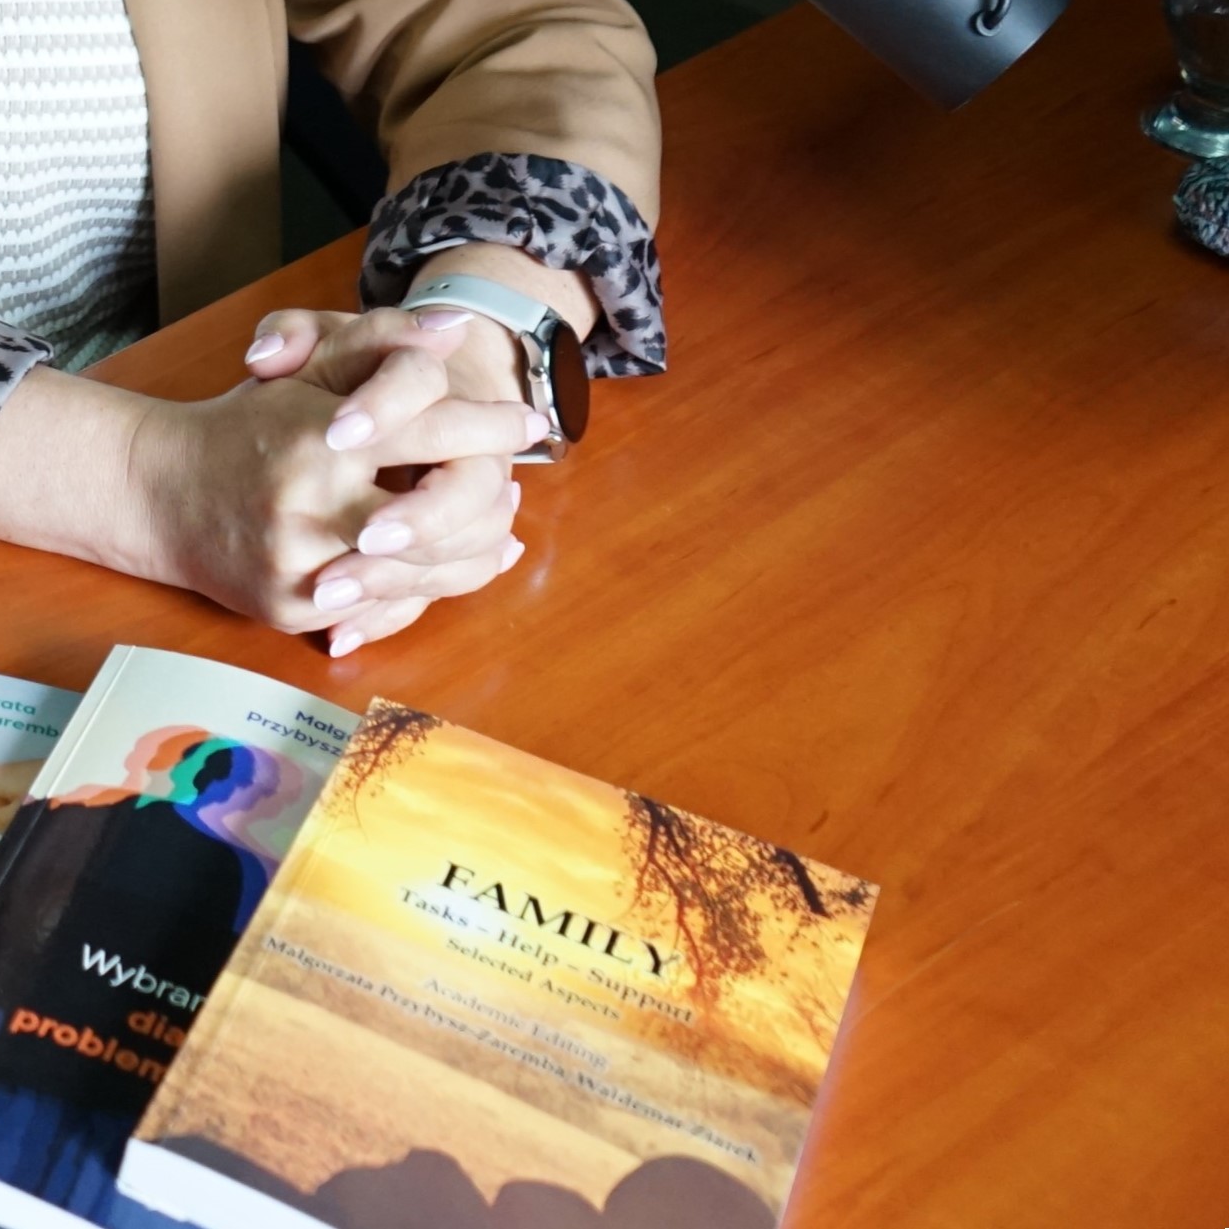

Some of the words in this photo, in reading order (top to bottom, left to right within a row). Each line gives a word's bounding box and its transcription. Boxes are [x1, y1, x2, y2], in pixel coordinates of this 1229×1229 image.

[401, 886, 469, 928] Tasks
[497, 929, 559, 967] Help
[587, 968, 694, 1023] Support
[437, 860, 680, 977] FAMILY
[424, 977, 521, 1030] Academic
[446, 937, 533, 983] Selected
[539, 977, 620, 1021] Aspects
